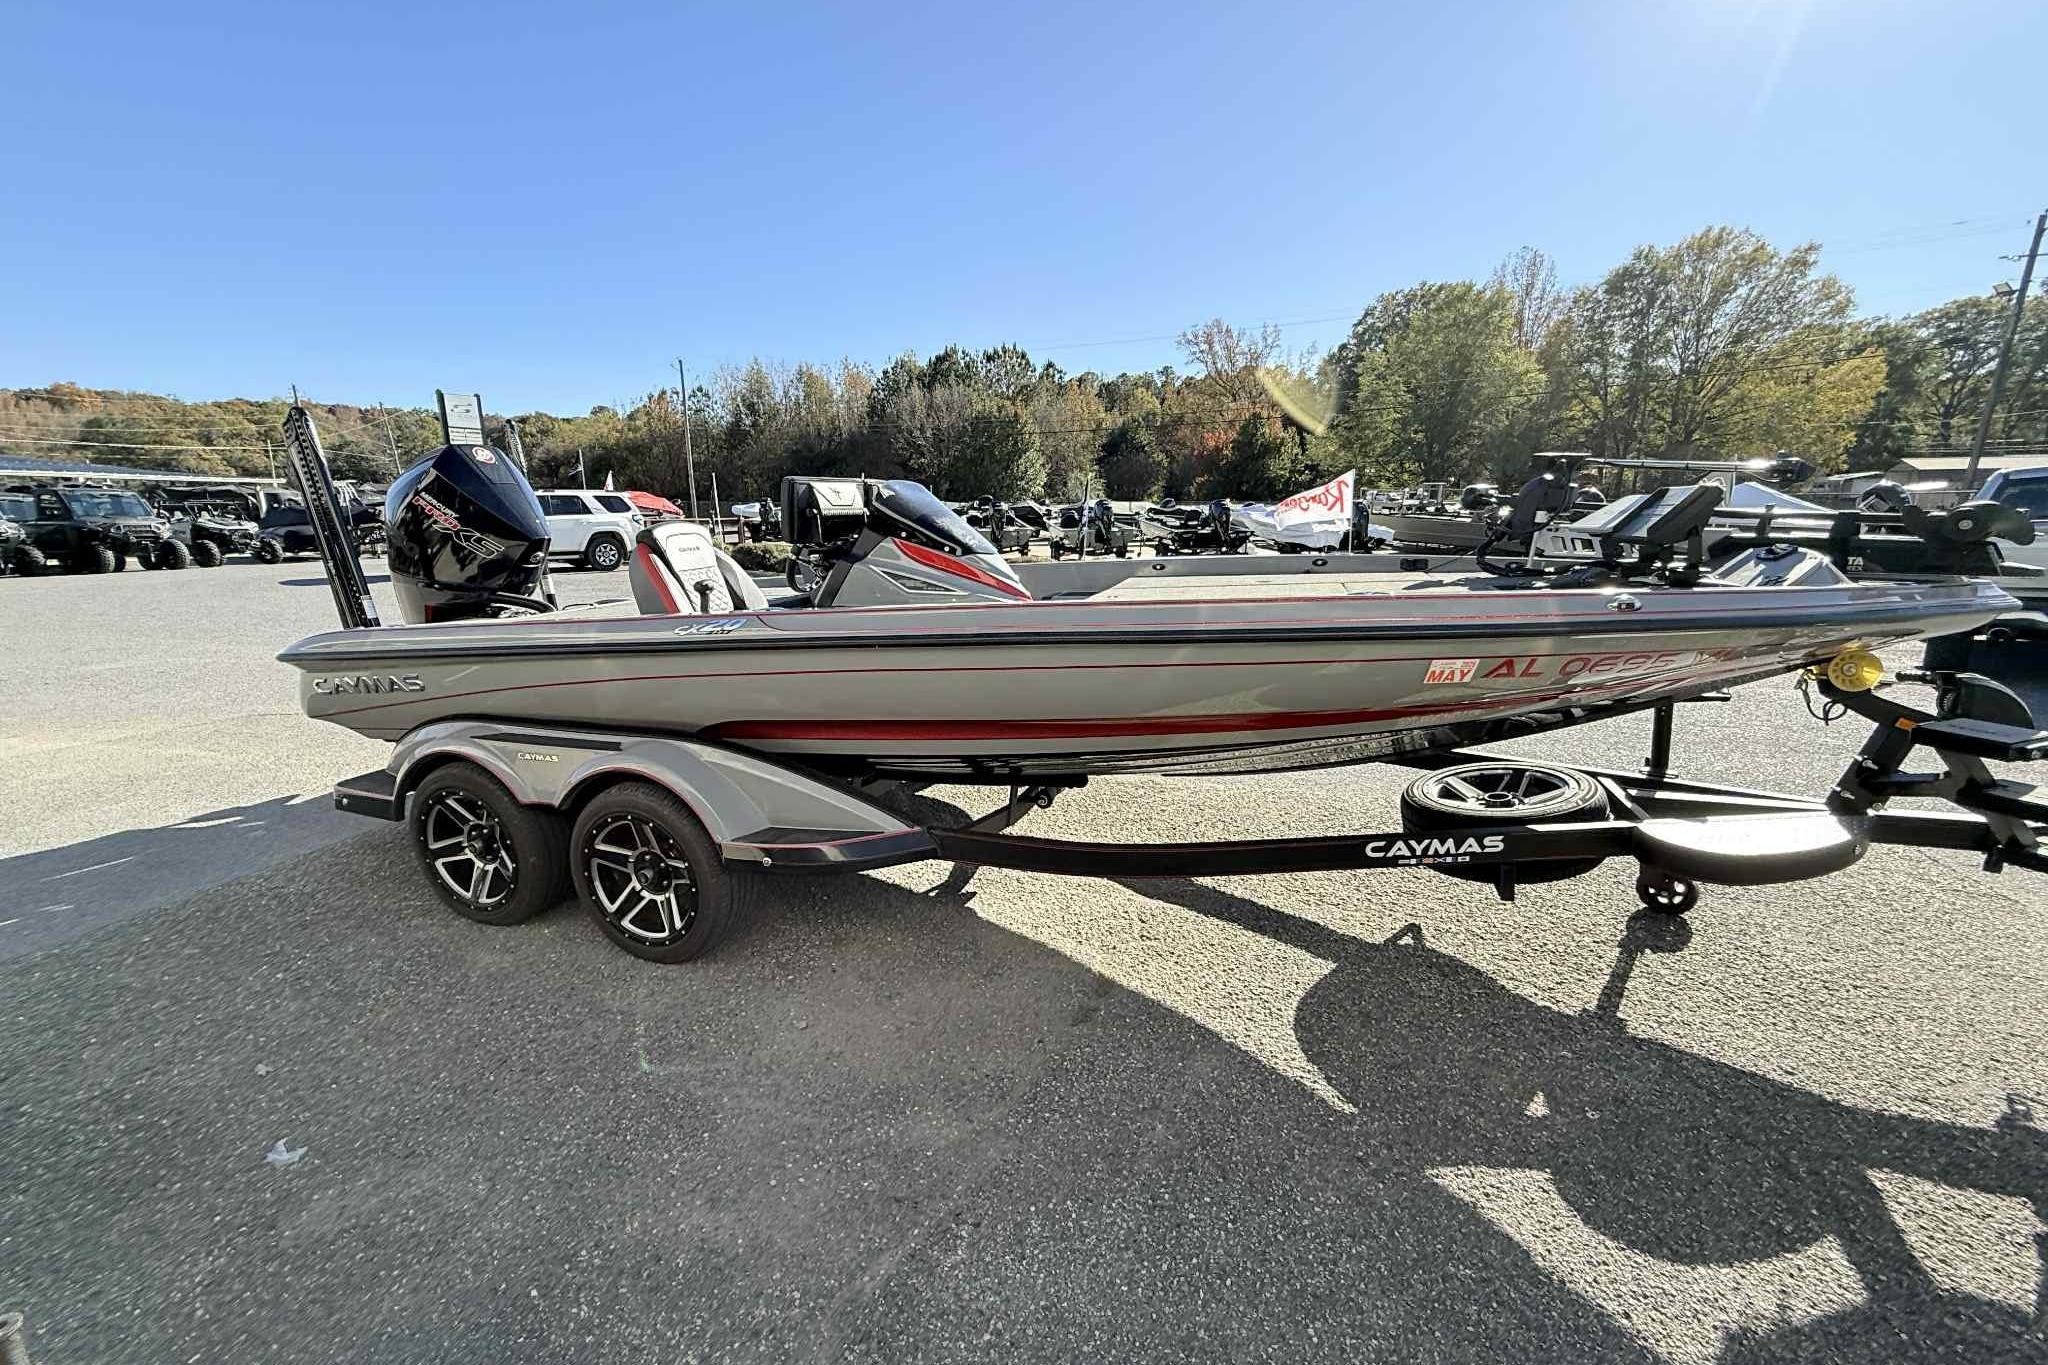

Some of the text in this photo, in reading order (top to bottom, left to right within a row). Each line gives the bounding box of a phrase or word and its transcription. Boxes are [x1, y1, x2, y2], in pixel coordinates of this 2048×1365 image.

[1426, 669, 1472, 683] MAY
[1480, 658, 1544, 678] AL
[312, 673, 426, 694] CAYMAS
[517, 752, 559, 762] CAYMAS
[1365, 835, 1505, 858] CAYMAS
